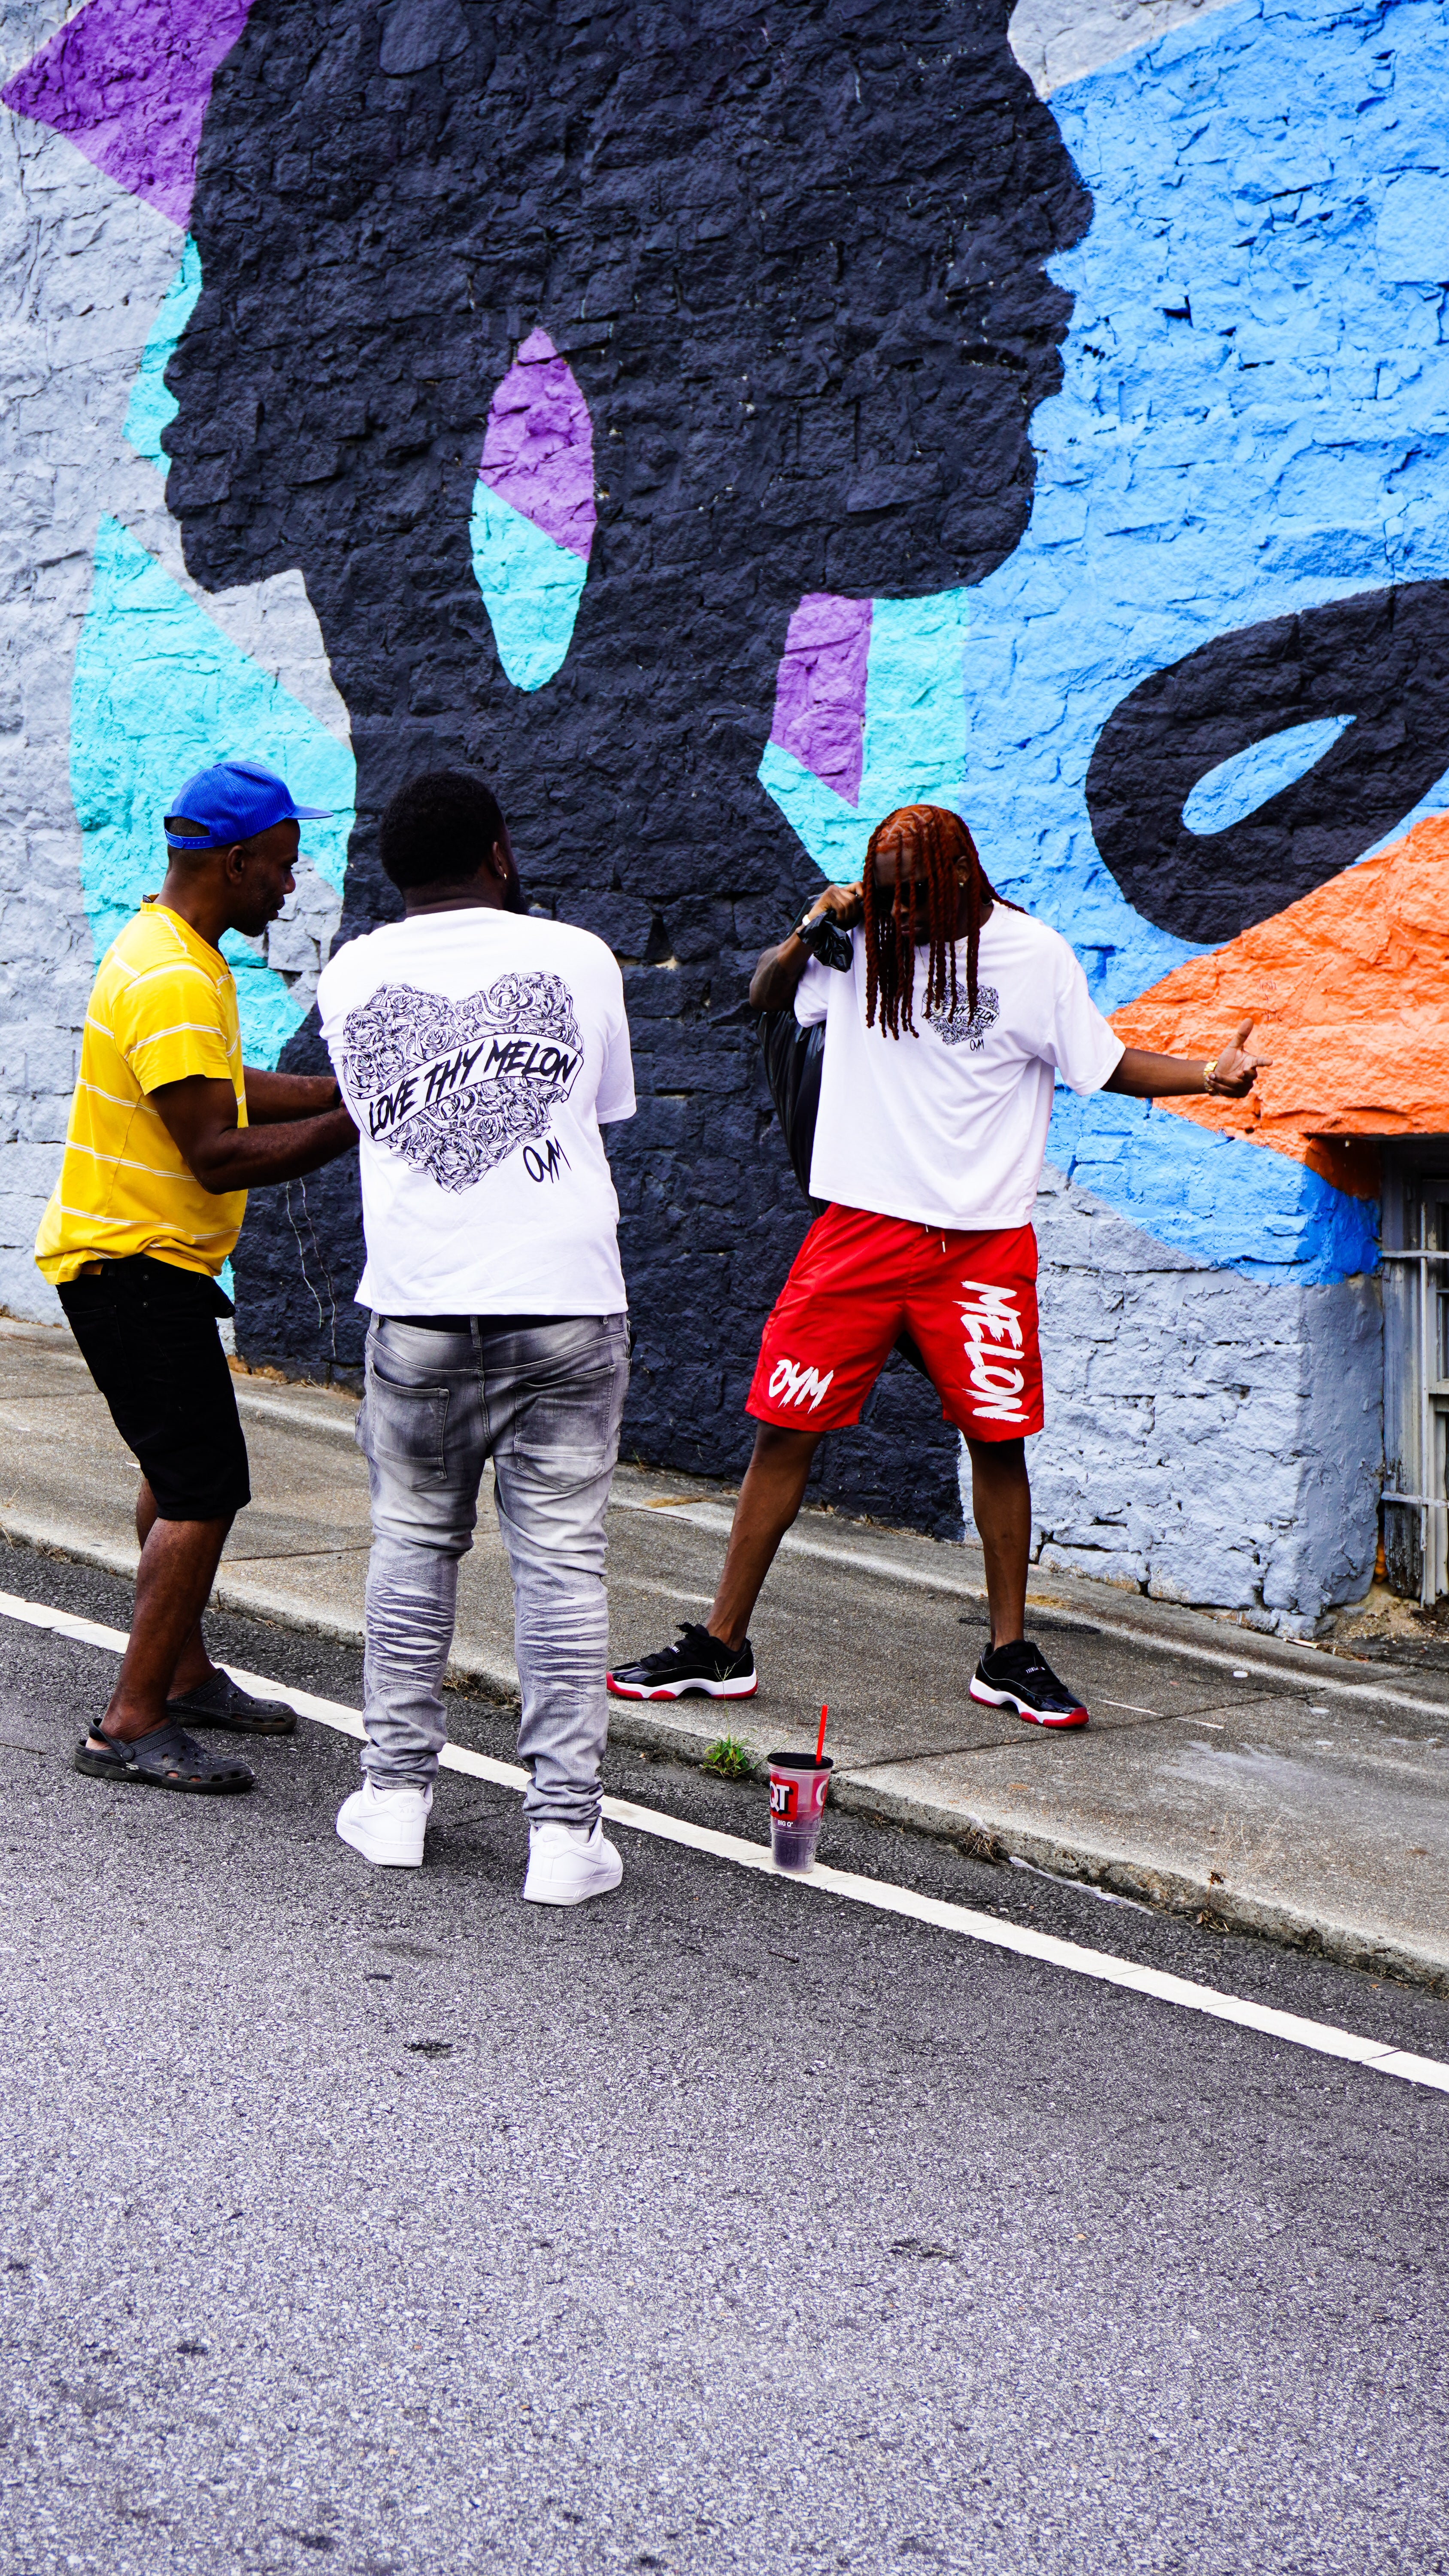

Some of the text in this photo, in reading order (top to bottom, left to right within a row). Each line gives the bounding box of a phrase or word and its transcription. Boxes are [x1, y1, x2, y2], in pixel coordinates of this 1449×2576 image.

[967, 1006, 997, 1023] ELON
[970, 1039, 984, 1051] OYM
[369, 1036, 579, 1139] LOVE THY MELON
[523, 1135, 572, 1184] OYM
[952, 1281, 1030, 1423] MELON
[768, 1359, 834, 1414] OYM
[770, 1781, 790, 1812] QT
